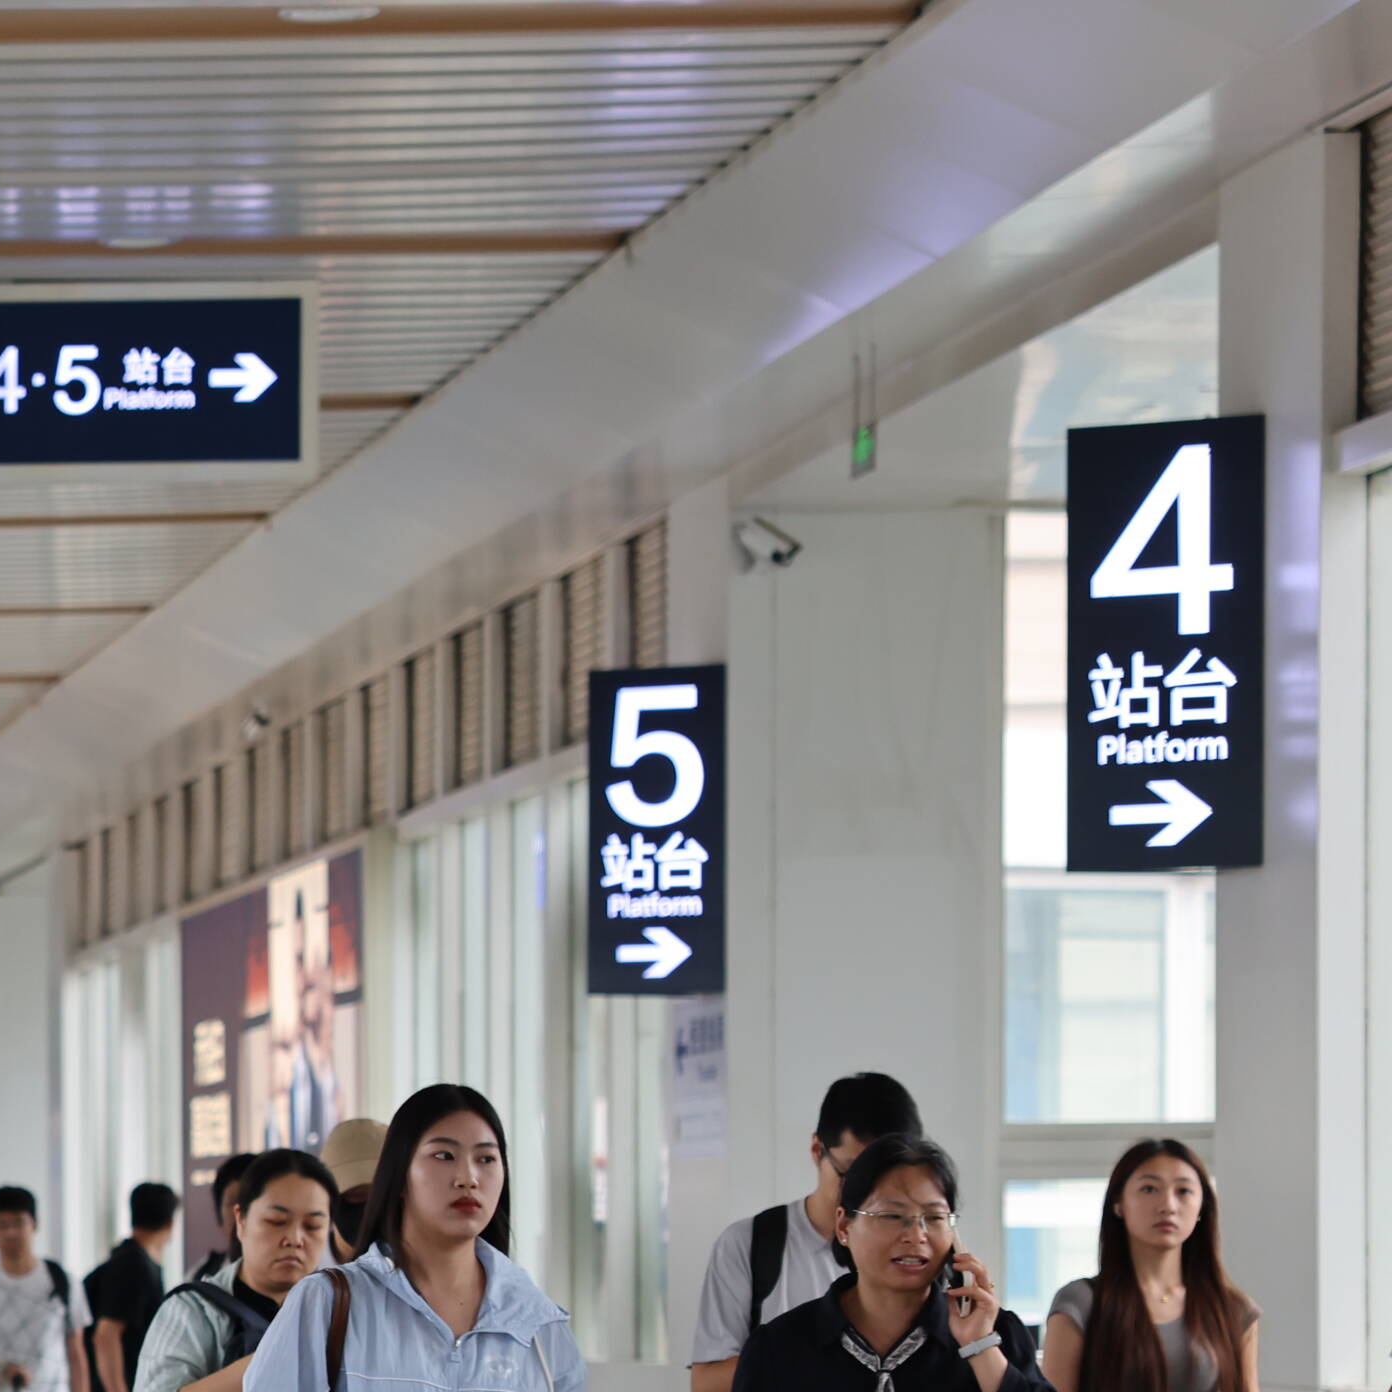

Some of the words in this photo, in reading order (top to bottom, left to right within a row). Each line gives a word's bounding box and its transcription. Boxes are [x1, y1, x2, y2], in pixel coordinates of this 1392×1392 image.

[122, 346, 196, 385] 站台
[103, 387, 196, 411] Platform
[1090, 443, 1234, 636] 4
[1088, 648, 1238, 729] 站台
[605, 683, 705, 828] 5
[1097, 731, 1229, 765] Platform
[600, 831, 709, 892] 站台
[606, 893, 703, 919] Platform
